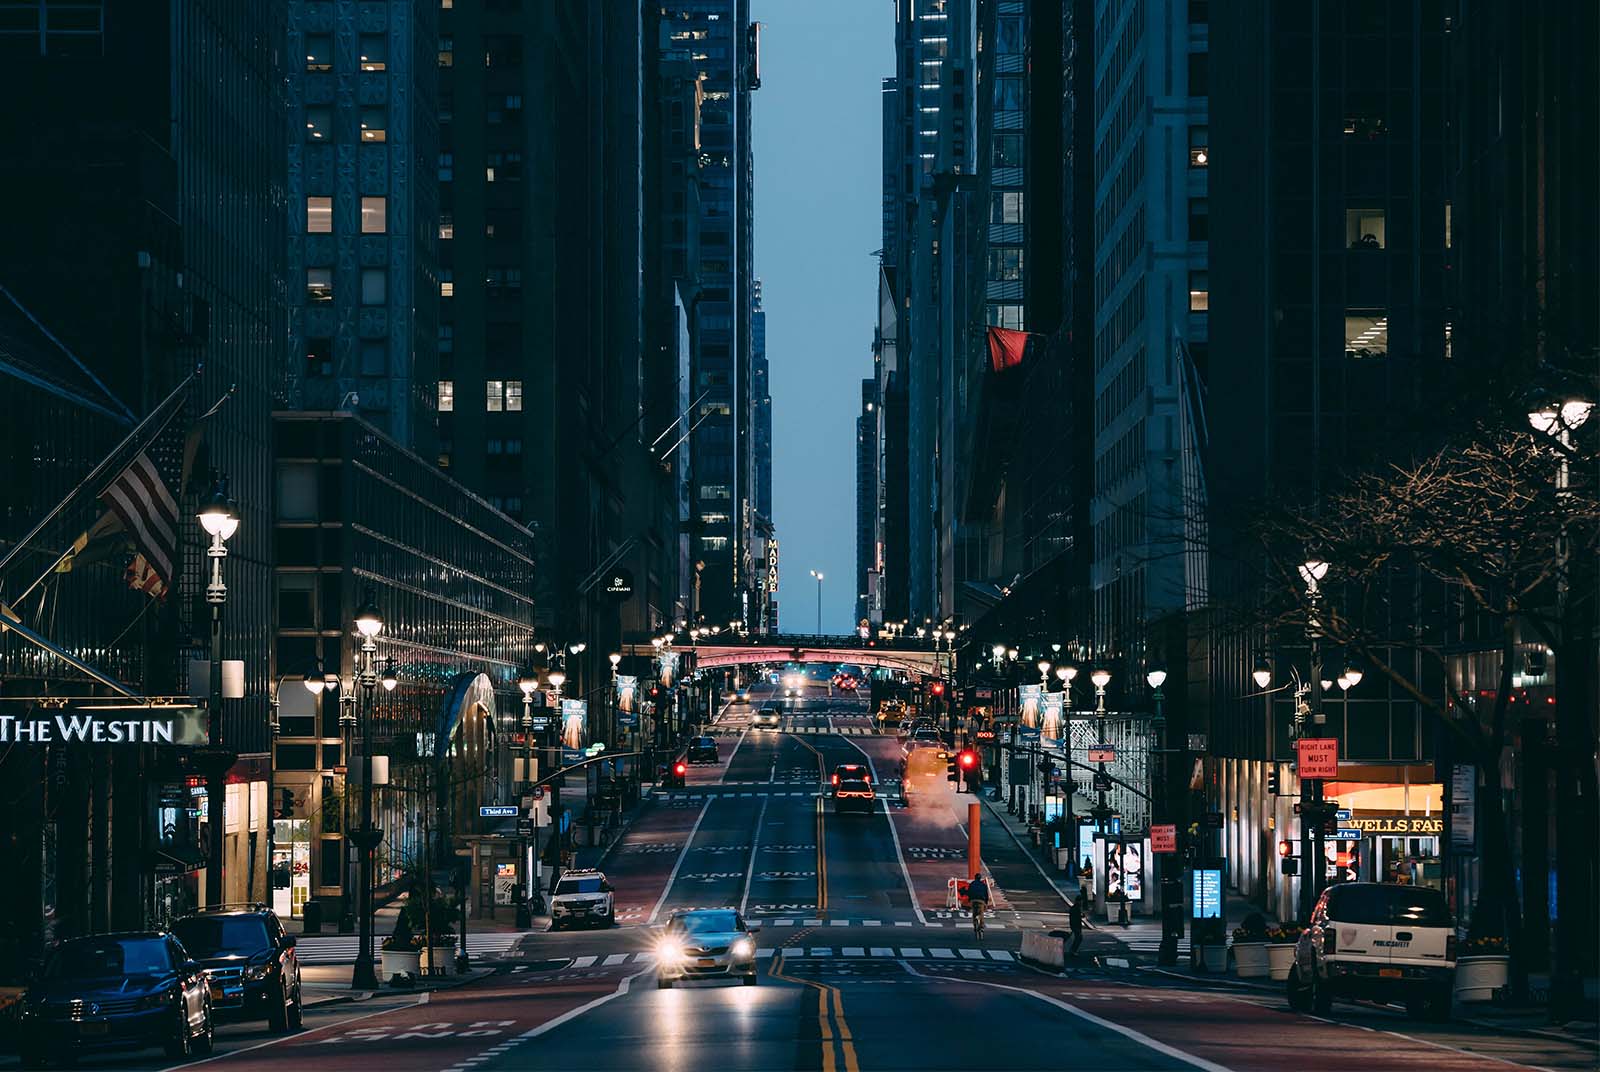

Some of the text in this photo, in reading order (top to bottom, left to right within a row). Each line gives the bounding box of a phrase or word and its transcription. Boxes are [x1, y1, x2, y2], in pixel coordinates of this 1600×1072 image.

[768, 539, 778, 592] MADAME
[0, 715, 174, 742] THE WESTIN
[1308, 754, 1328, 762] MUST
[484, 808, 514, 816] Third Ave
[1347, 819, 1408, 832] WELLS
